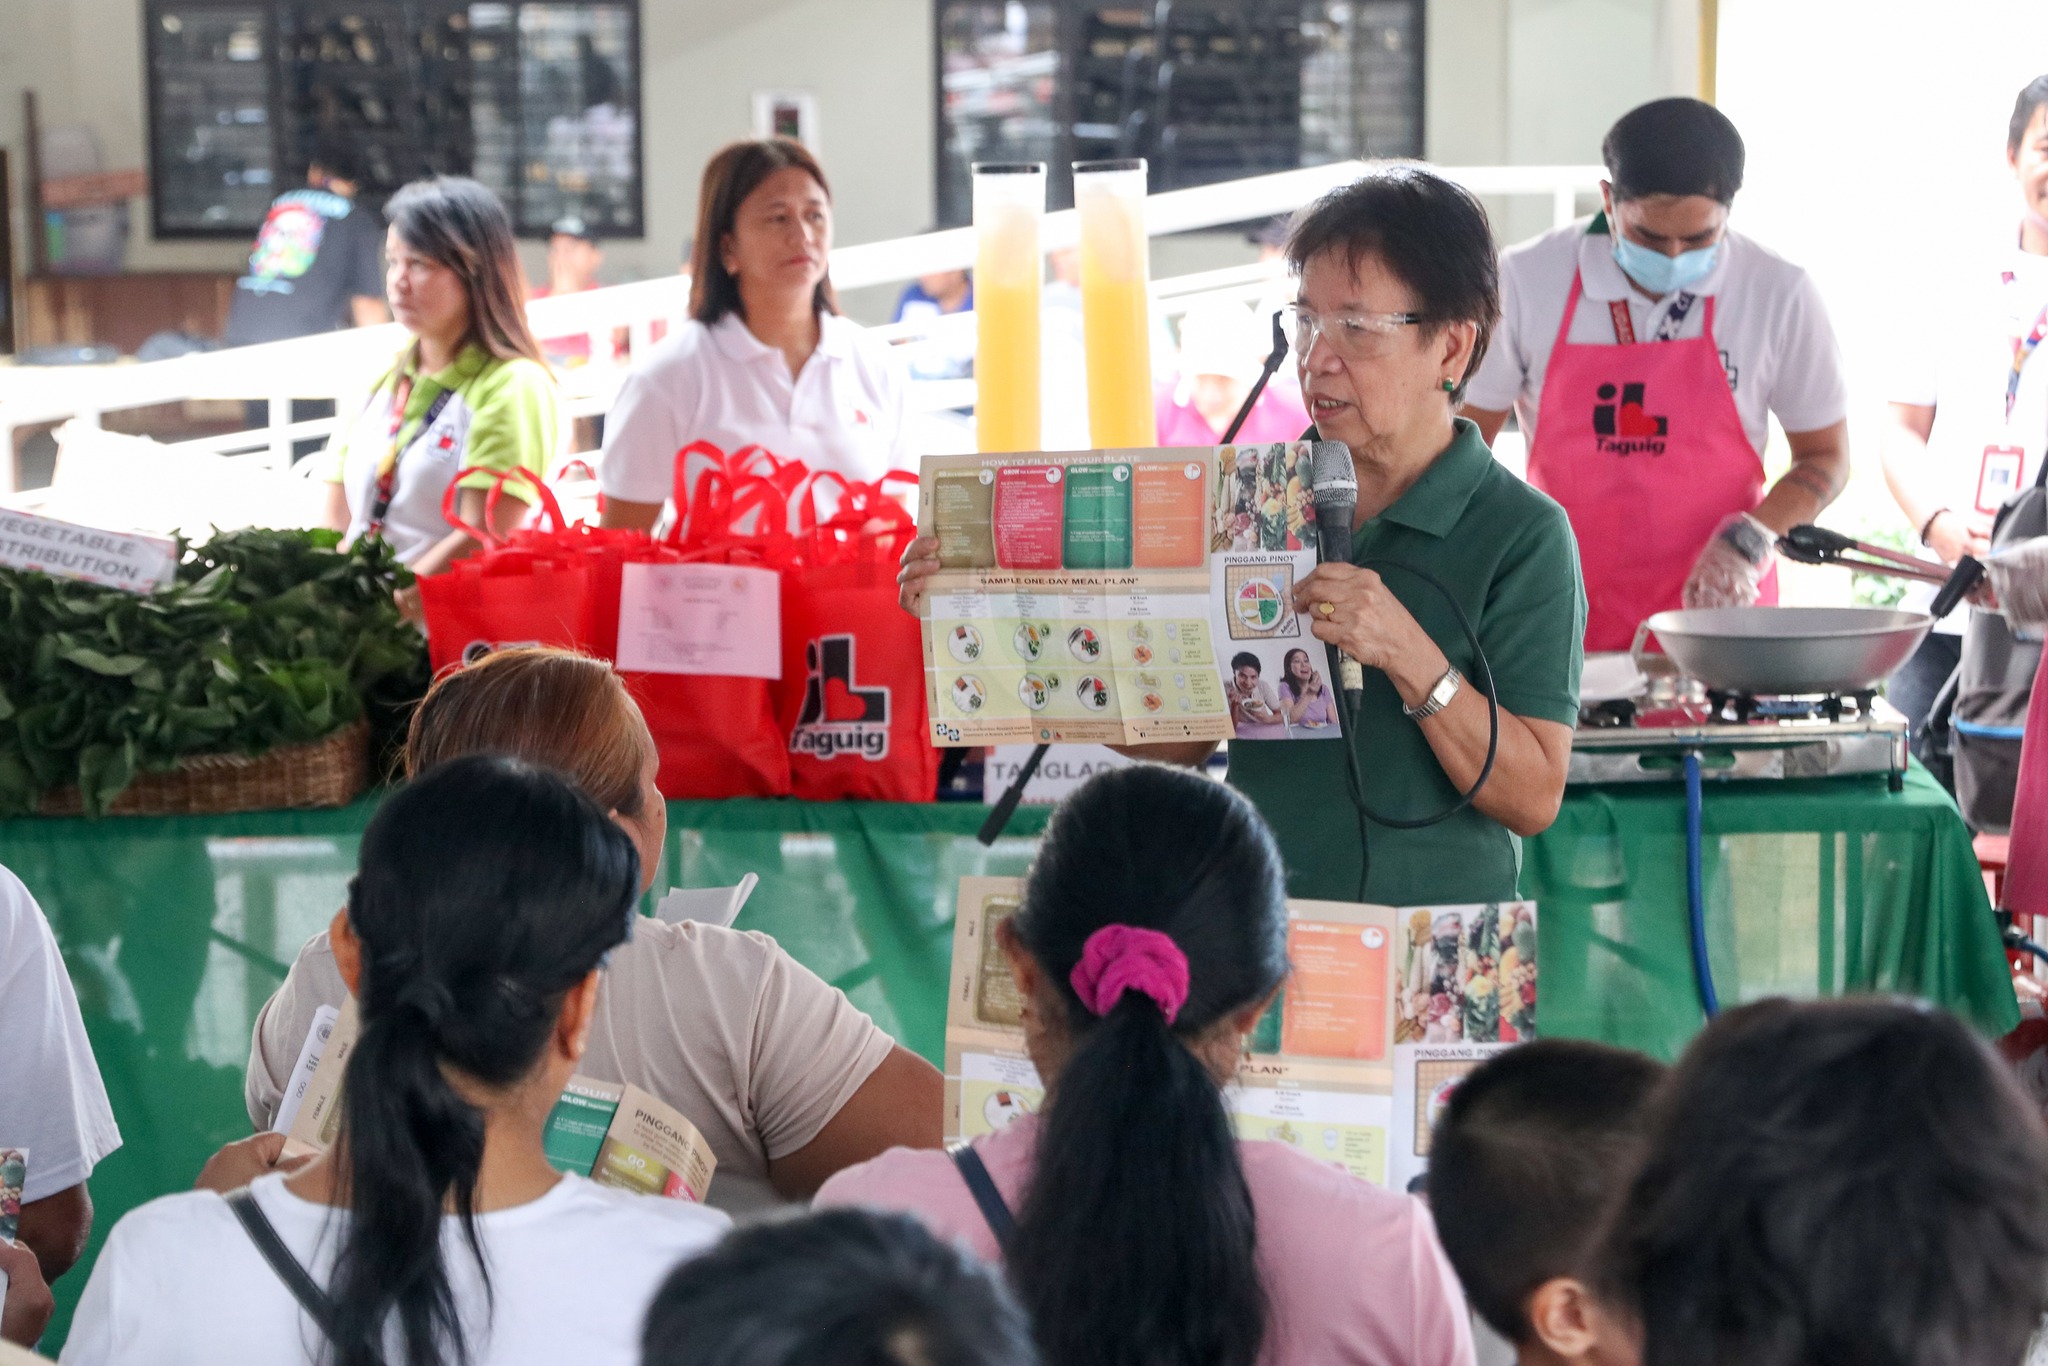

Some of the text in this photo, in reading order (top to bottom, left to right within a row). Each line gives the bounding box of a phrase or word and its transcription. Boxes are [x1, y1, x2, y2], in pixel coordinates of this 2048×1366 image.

[1597, 437, 1666, 457] Taguig
[981, 455, 1141, 467] HOW TO FILL UP YOUR PLATE
[1070, 466, 1089, 474] GLOW
[1138, 464, 1158, 472] GLOW
[0, 541, 138, 581] TRIBUTION
[1225, 555, 1267, 564] PINGGANG
[980, 577, 1022, 585] SAMPLE
[1023, 577, 1068, 586] ONE-DAY
[1071, 577, 1101, 586] MEAL
[791, 724, 885, 757] Taguig
[1296, 923, 1325, 933] GLOW
[338, 1042, 349, 1059] MALE
[1414, 1048, 1473, 1058] PINGGANG
[566, 1082, 612, 1100] YOUR
[561, 1094, 588, 1107] GLOW
[312, 1095, 325, 1120] FEMALE
[634, 1109, 691, 1151] PINGGANG
[691, 1148, 709, 1175] PINOY
[628, 1155, 645, 1169] GO
